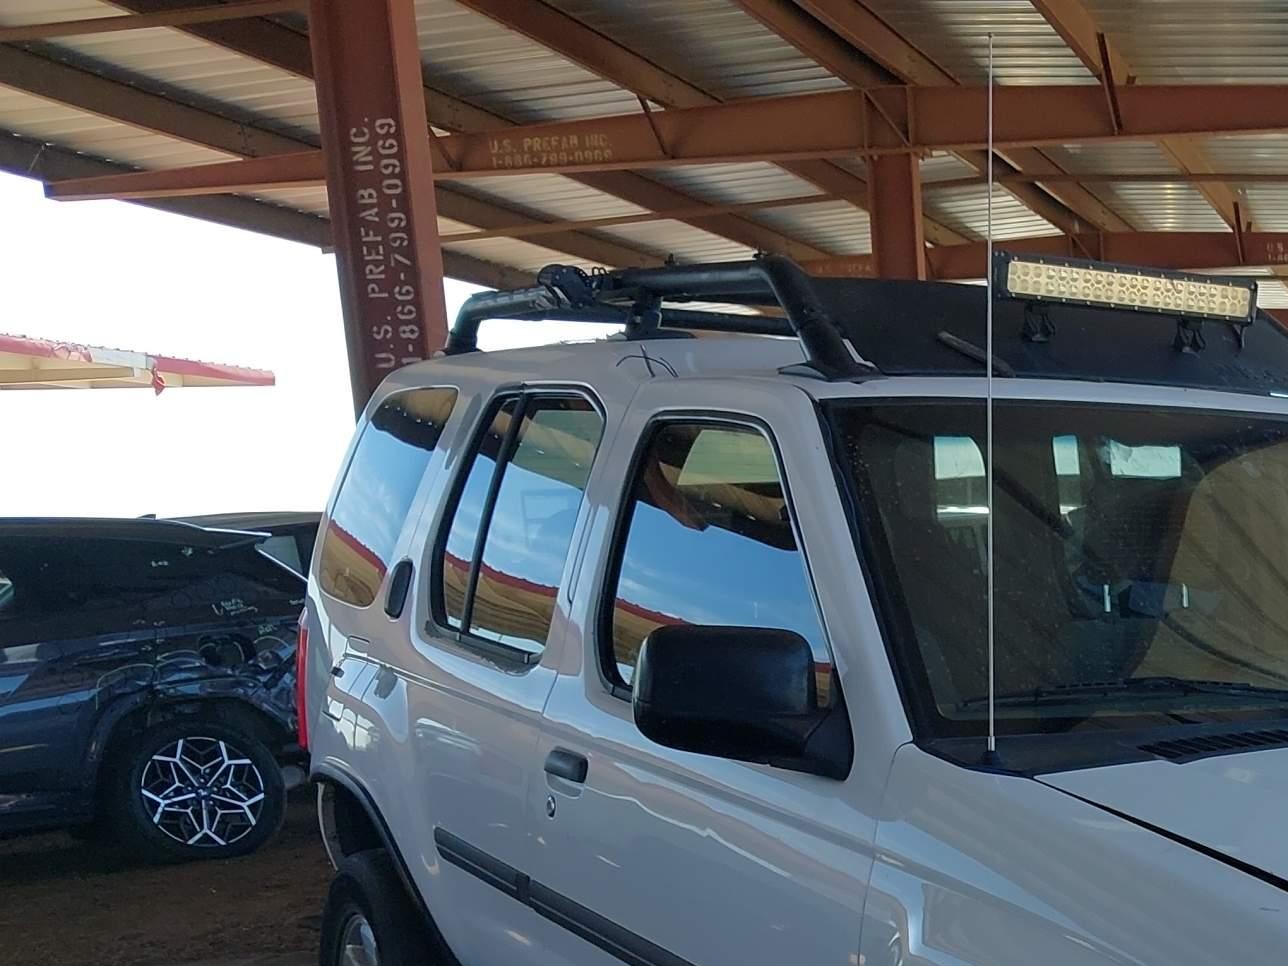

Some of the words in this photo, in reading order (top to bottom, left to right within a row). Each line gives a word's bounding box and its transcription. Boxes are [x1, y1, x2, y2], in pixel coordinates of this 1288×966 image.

[350, 116, 375, 172] INC.
[356, 187, 389, 299] PREFAB
[374, 117, 422, 366] 1-866-799-0969
[373, 315, 395, 369] U.S.
